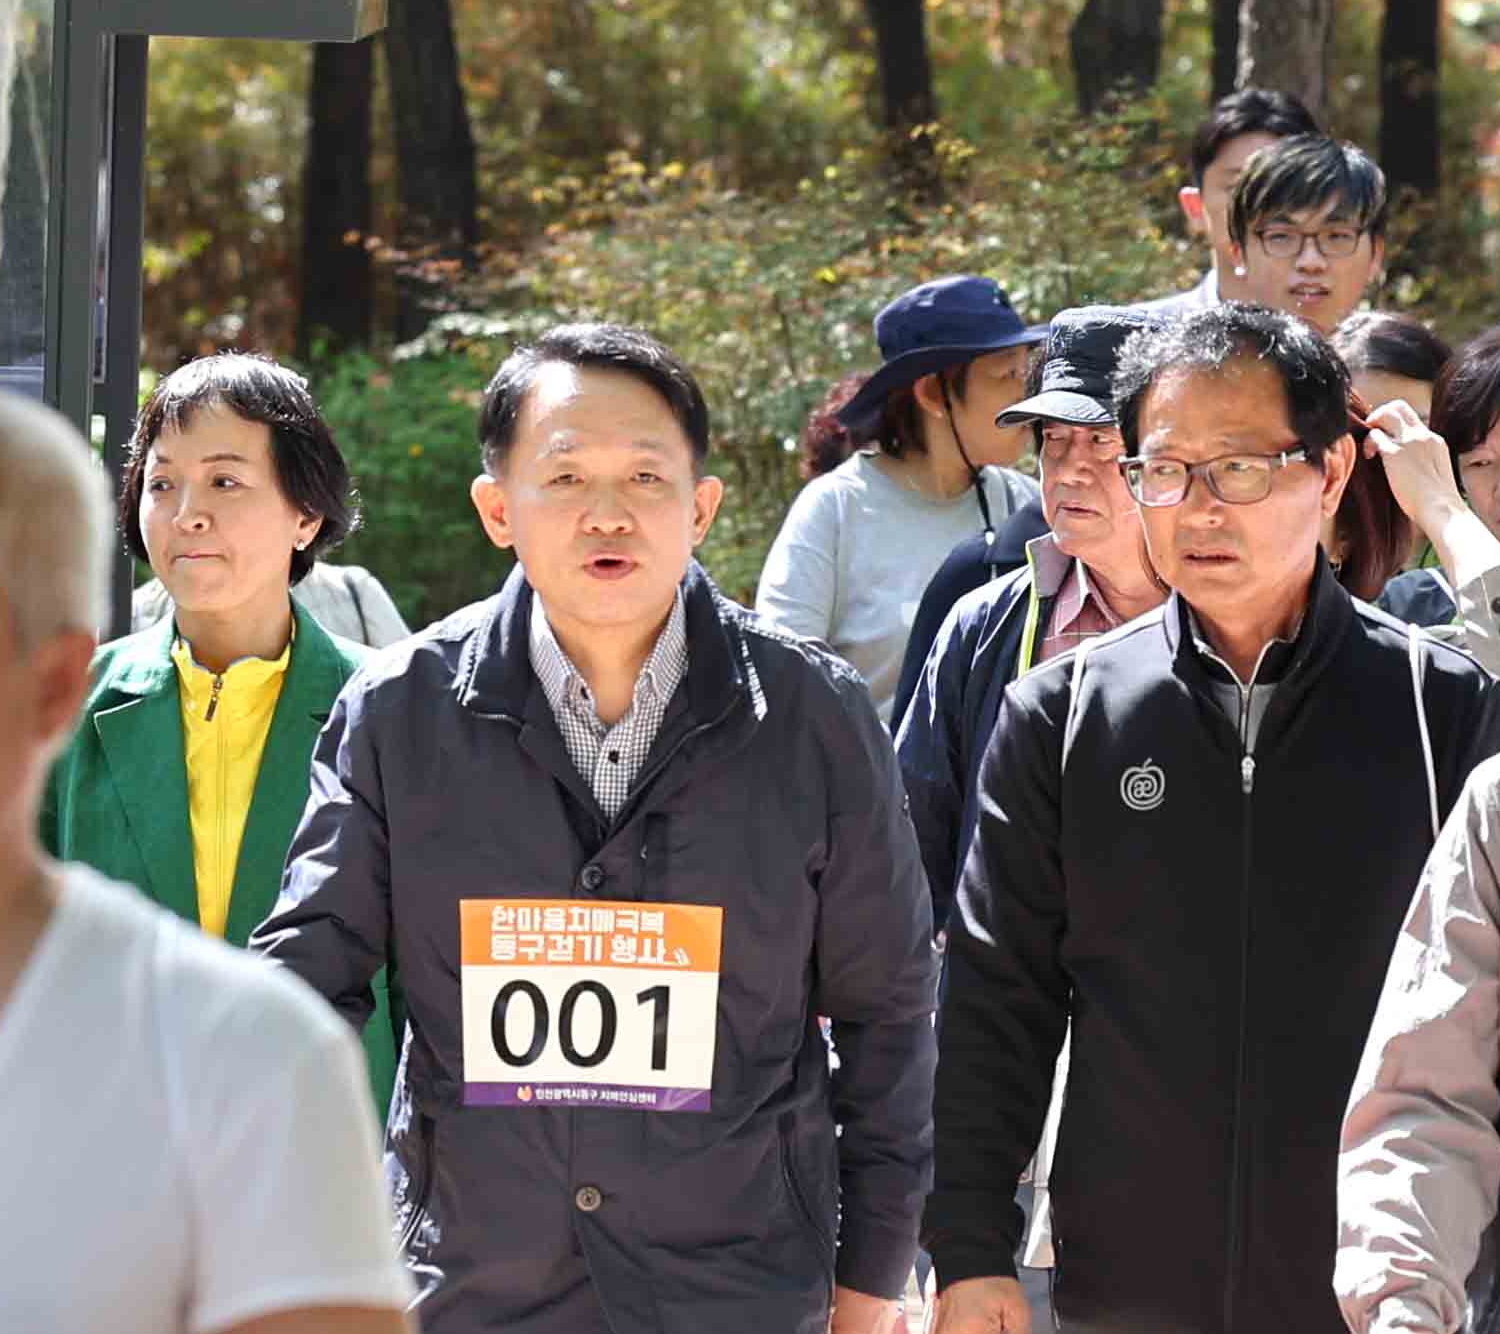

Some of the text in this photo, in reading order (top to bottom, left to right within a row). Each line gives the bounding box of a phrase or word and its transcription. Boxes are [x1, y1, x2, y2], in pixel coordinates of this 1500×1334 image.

[491, 905, 665, 935] 한마음치매극복
[490, 933, 668, 965] 동구걷기 행사
[490, 978, 671, 1071] 001
